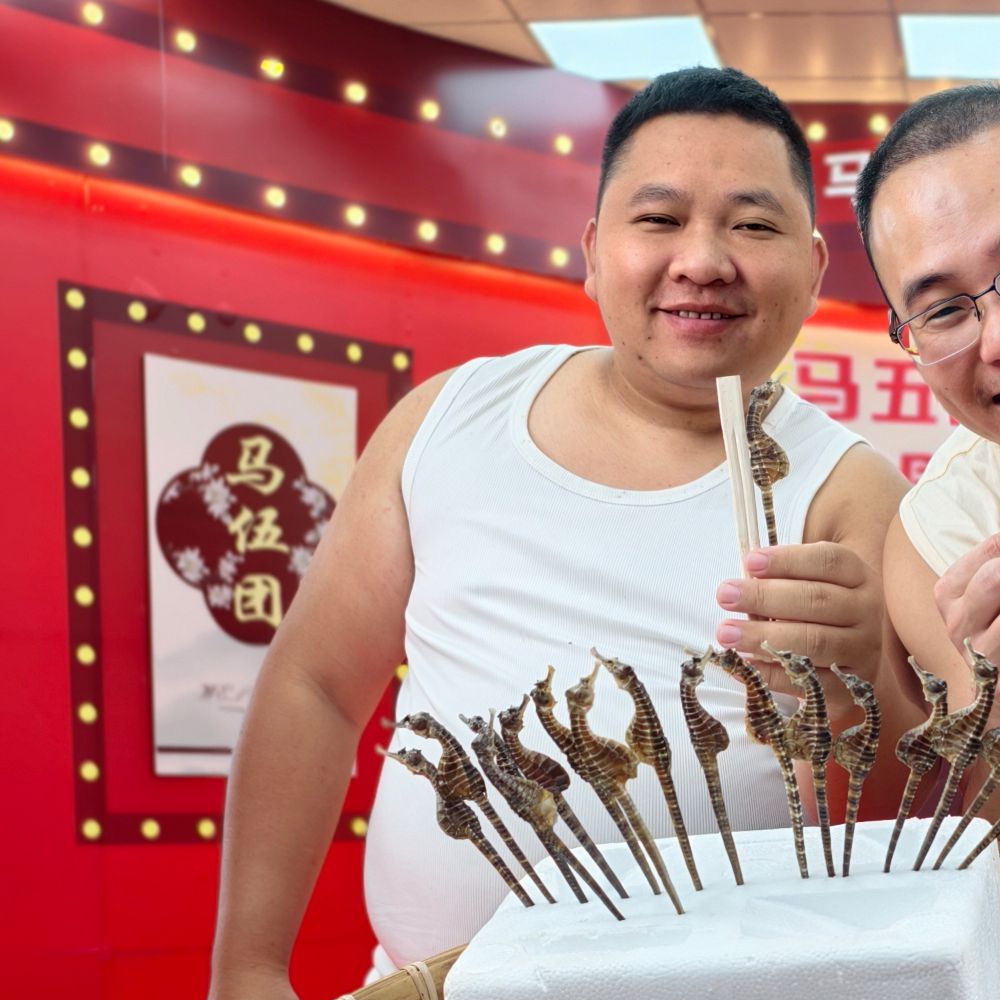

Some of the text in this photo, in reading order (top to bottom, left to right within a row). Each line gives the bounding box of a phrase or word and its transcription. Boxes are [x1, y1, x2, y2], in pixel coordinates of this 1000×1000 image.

[794, 351, 959, 424] 马五
[225, 435, 290, 630] 马伍团
